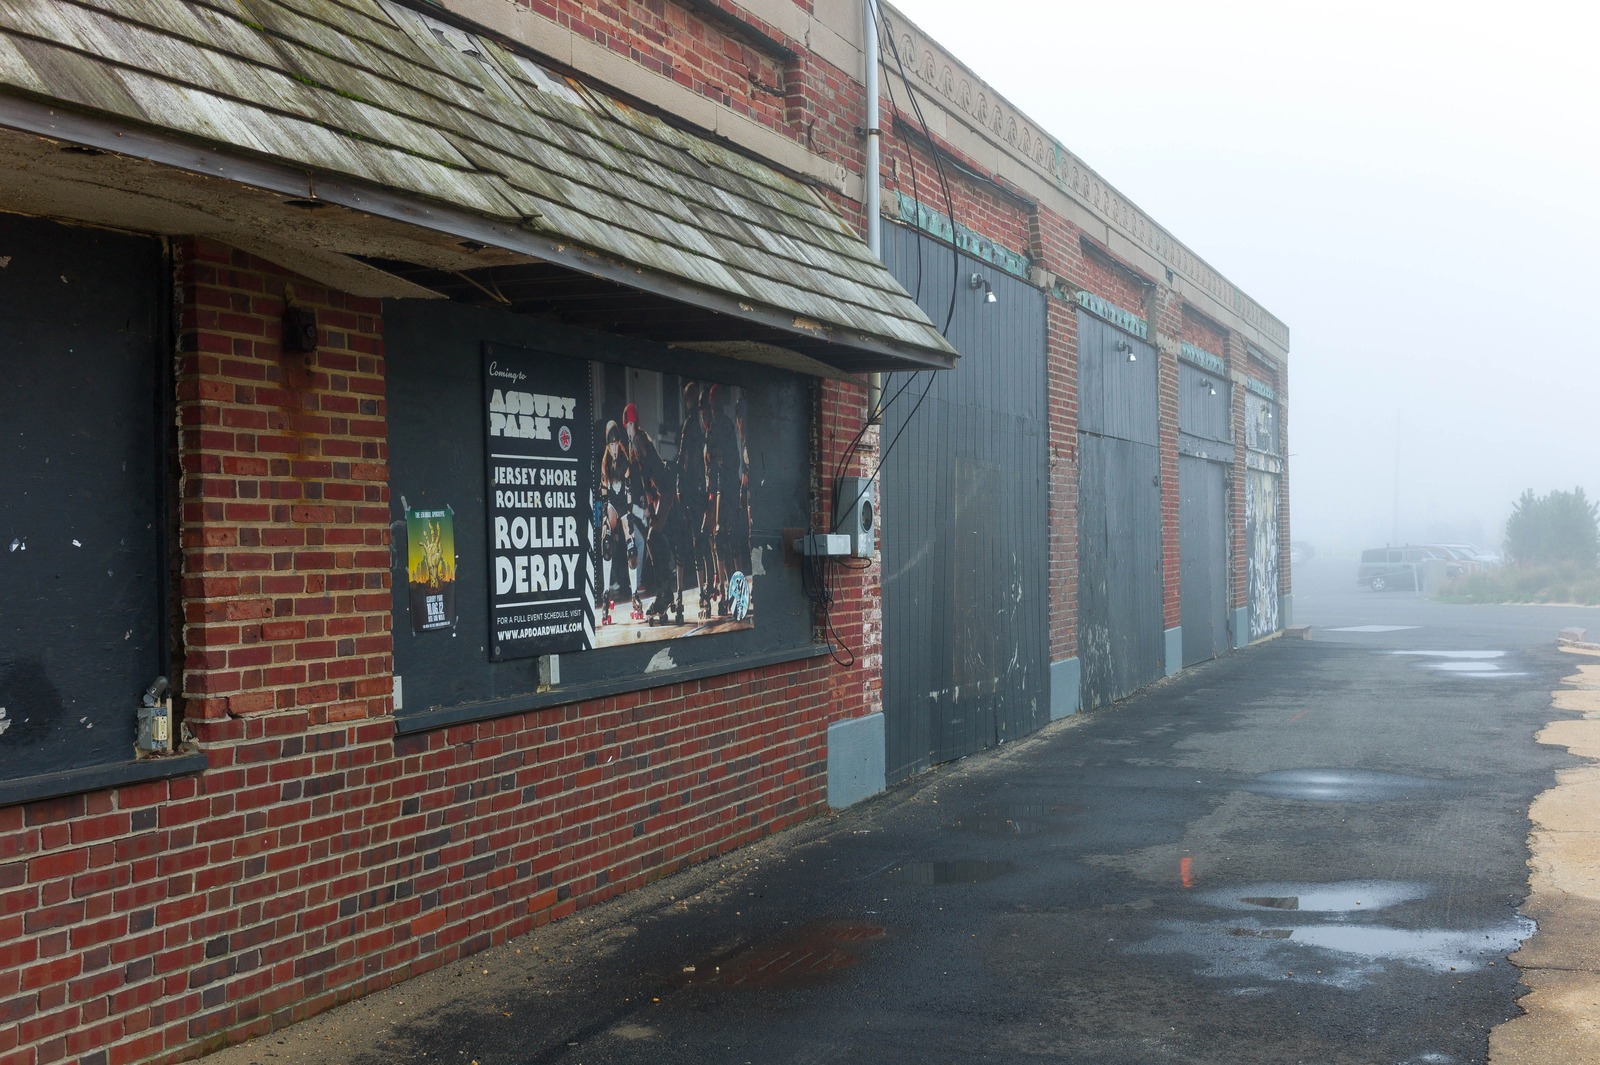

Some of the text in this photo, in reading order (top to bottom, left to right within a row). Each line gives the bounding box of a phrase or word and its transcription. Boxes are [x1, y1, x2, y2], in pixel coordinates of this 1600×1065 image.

[489, 361, 527, 384] Coming to
[490, 389, 576, 420] ASBURY
[490, 412, 552, 440] PARK
[494, 466, 577, 486] JERSEY SHORE
[496, 490, 576, 508] ROLLER GIRLS
[495, 516, 579, 550] ROLLER
[495, 554, 580, 595] DERBY
[497, 616, 508, 624] FOR
[514, 615, 526, 623] FULL
[527, 613, 543, 622] EVENT
[544, 611, 570, 620] SCHEDULE,
[570, 609, 582, 617] VISIT
[497, 622, 583, 641] WWW.APBOARDWALK.COM
